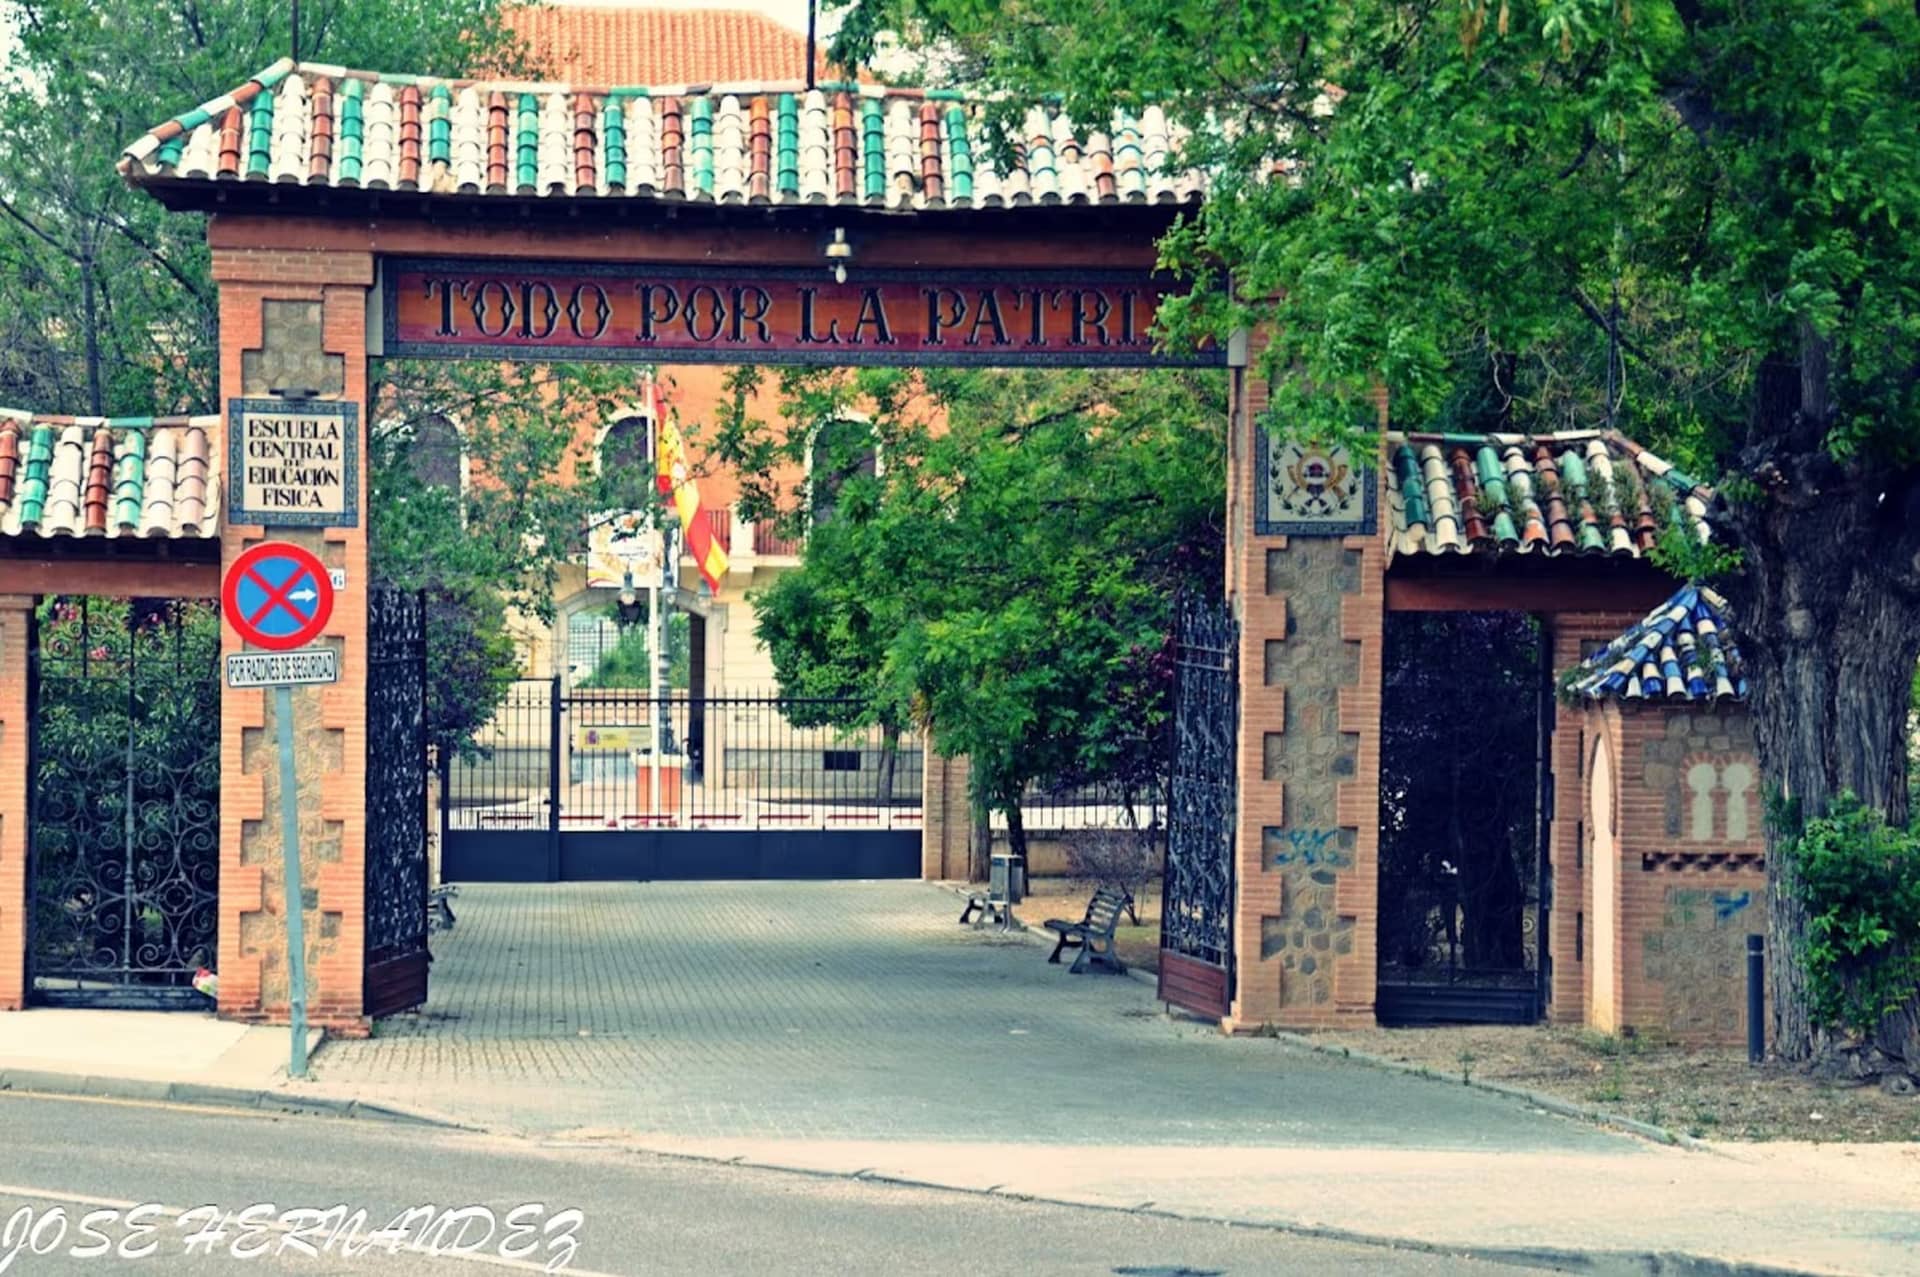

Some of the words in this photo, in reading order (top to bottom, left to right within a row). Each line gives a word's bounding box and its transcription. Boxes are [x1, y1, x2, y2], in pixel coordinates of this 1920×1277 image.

[424, 278, 612, 340] TODO
[635, 281, 773, 344] POR
[795, 286, 898, 345] LA
[919, 287, 1157, 346] PATRI
[248, 419, 339, 439] ESCUELA
[248, 441, 339, 460] CENTRAL
[283, 459, 304, 467] DE
[248, 466, 339, 486] EDUCACIÓN
[262, 488, 323, 507] FISICA
[229, 659, 245, 681] POR
[246, 657, 281, 680] RAZONES
[281, 656, 292, 679] DE
[292, 654, 334, 679] SEGURIDAD
